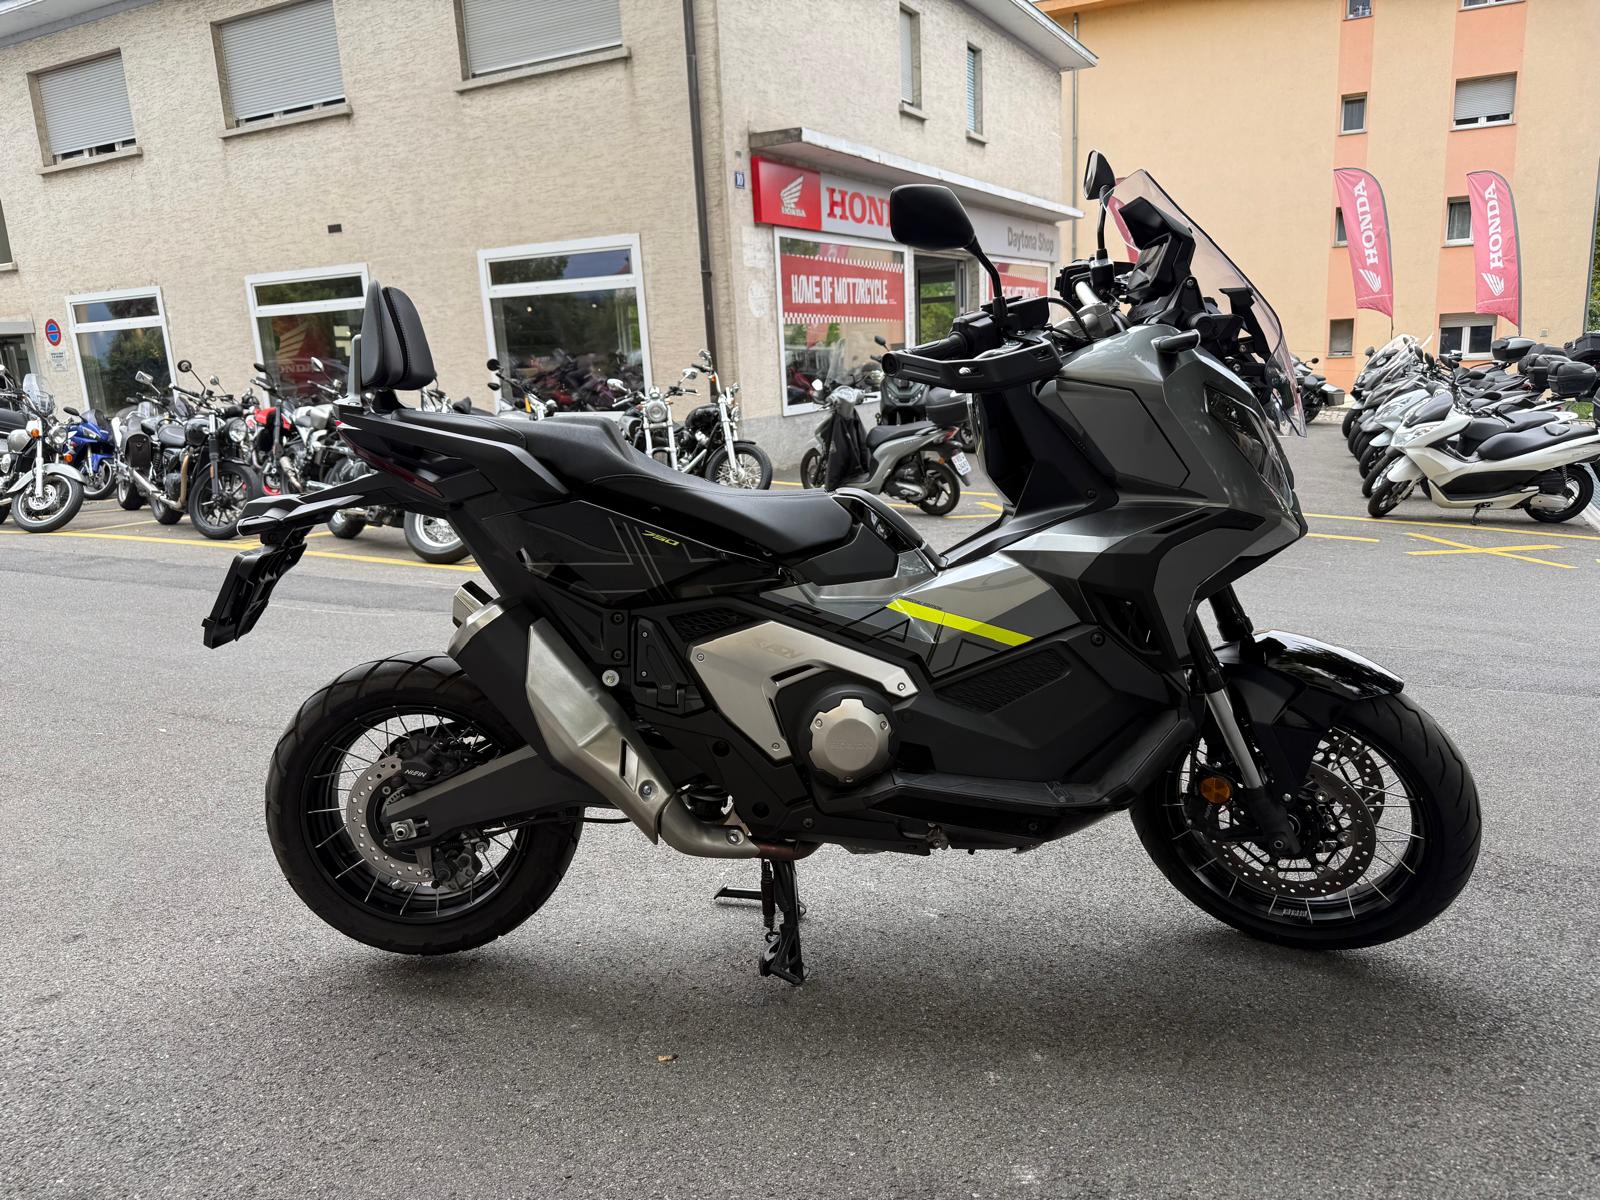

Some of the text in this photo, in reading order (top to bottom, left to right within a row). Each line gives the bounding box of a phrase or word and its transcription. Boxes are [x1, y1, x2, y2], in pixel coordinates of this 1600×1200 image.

[826, 187, 890, 227] HON
[1353, 178, 1378, 265] HONDA
[1007, 226, 1055, 256] Daytona Shop
[1484, 180, 1504, 270] HONDA
[791, 274, 821, 304] HOME
[821, 275, 833, 304] OF
[641, 530, 679, 545] 750
